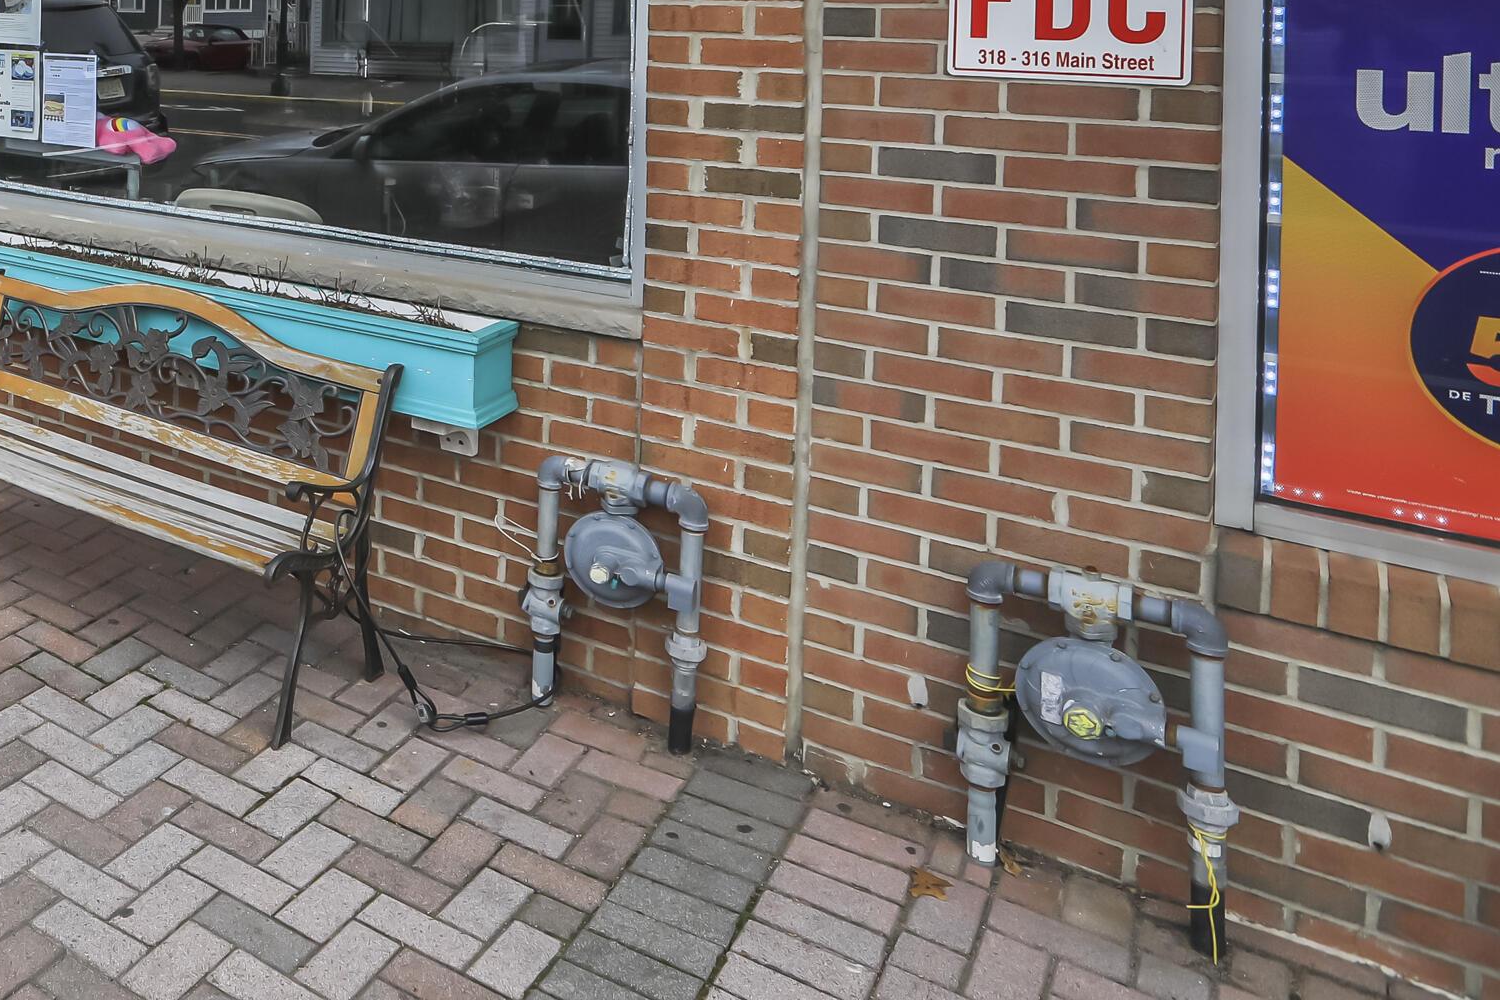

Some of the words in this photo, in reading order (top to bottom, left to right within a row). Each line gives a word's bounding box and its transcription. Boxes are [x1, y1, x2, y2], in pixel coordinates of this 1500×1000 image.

[977, 49, 1006, 65] 318
[1021, 50, 1051, 67] 316
[1056, 52, 1096, 69] Main
[1102, 53, 1155, 71] Street
[1449, 389, 1472, 402] DE
